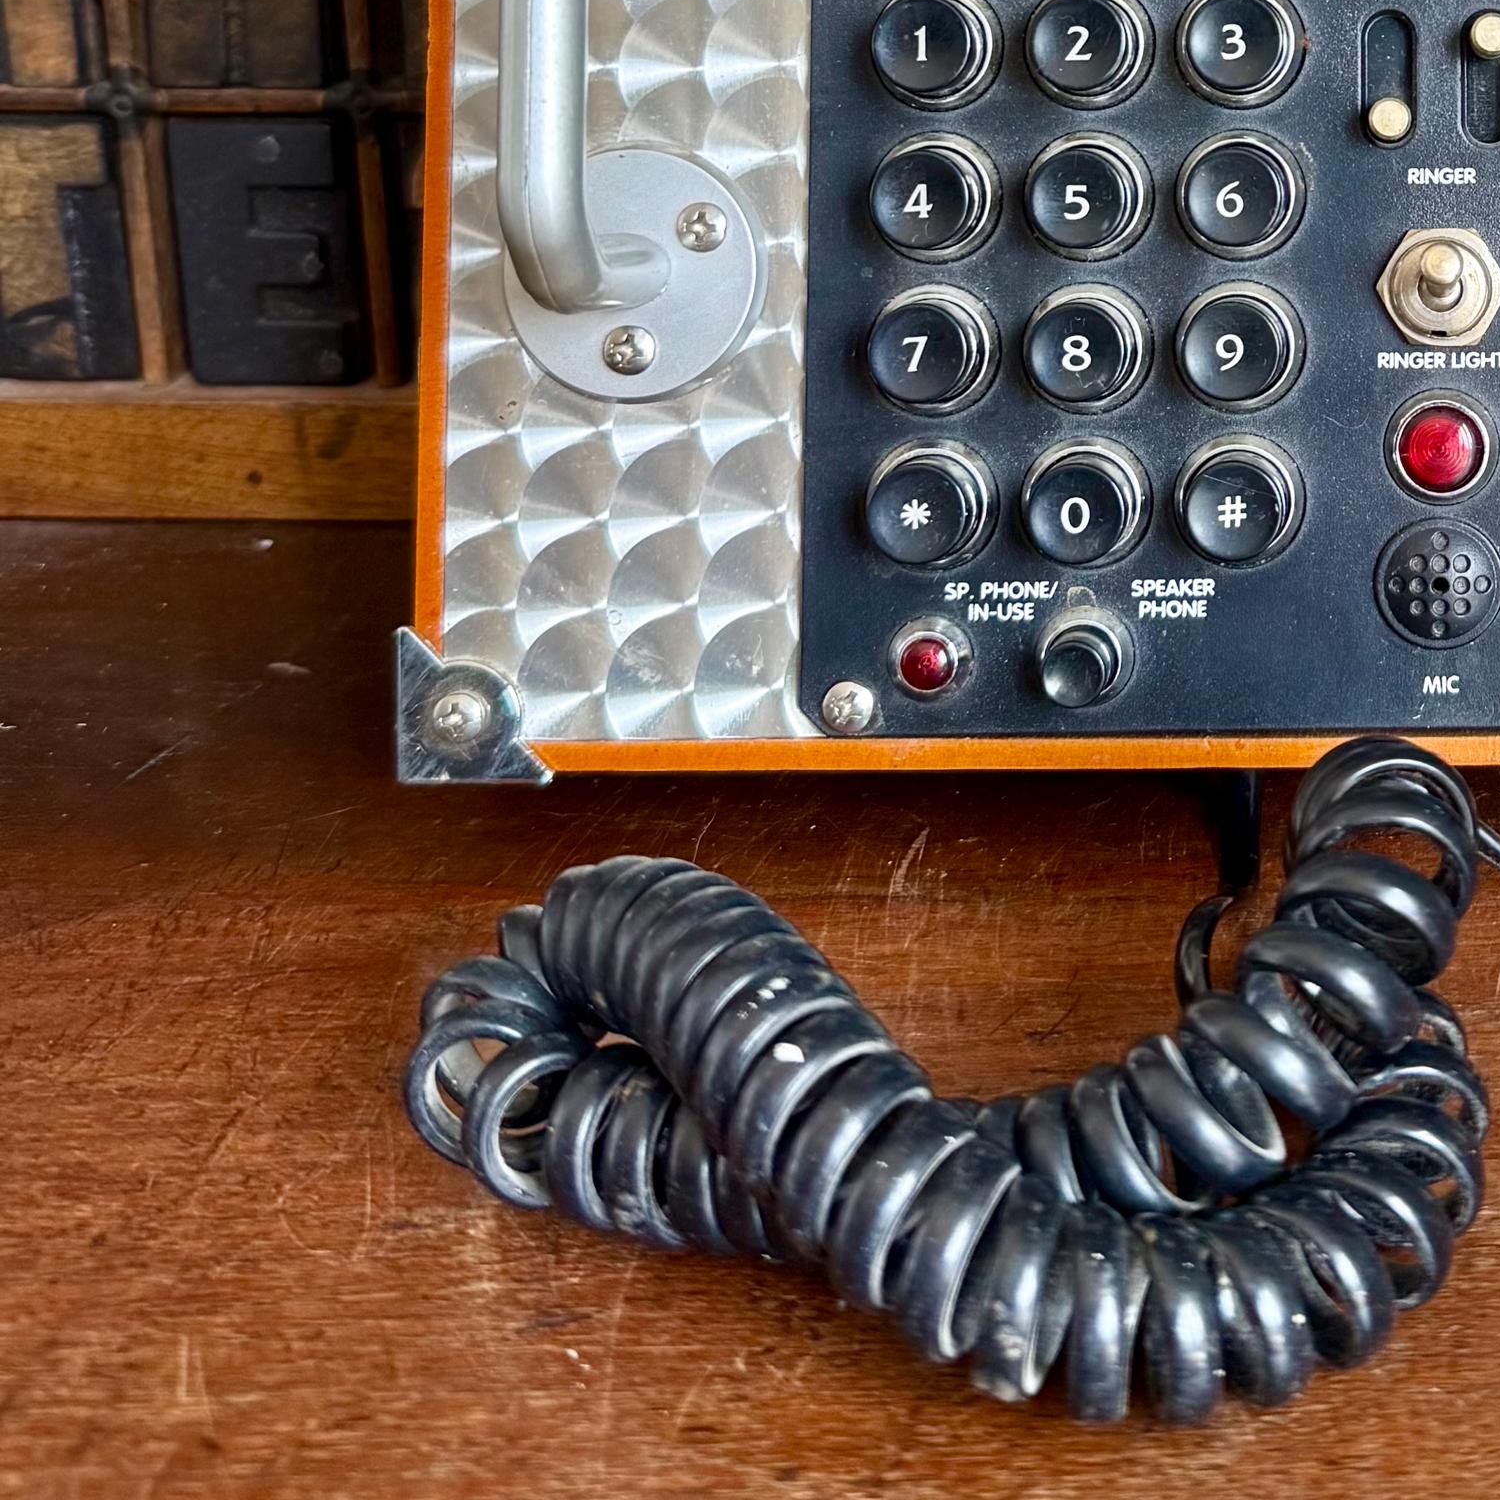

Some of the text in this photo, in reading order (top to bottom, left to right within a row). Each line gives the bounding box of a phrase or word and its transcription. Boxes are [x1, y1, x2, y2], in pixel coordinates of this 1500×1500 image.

[913, 26, 928, 62] 1
[1065, 26, 1092, 61] 2
[1220, 24, 1247, 61] 3
[1407, 168, 1477, 185] RINGER
[902, 184, 933, 219] 4
[1063, 184, 1090, 220] 5
[1215, 181, 1244, 218] 6
[902, 336, 928, 373] 7
[1061, 335, 1092, 372] 8
[1215, 334, 1244, 372] 9
[1377, 352, 1447, 369] RINGER
[1217, 495, 1248, 528] #
[944, 581, 1059, 601] SP. PHONE/
[1131, 579, 1216, 598] SPEAKER
[967, 603, 1035, 622] IN-USE
[1138, 600, 1208, 619] PHONE
[1422, 674, 1460, 695] MIC
